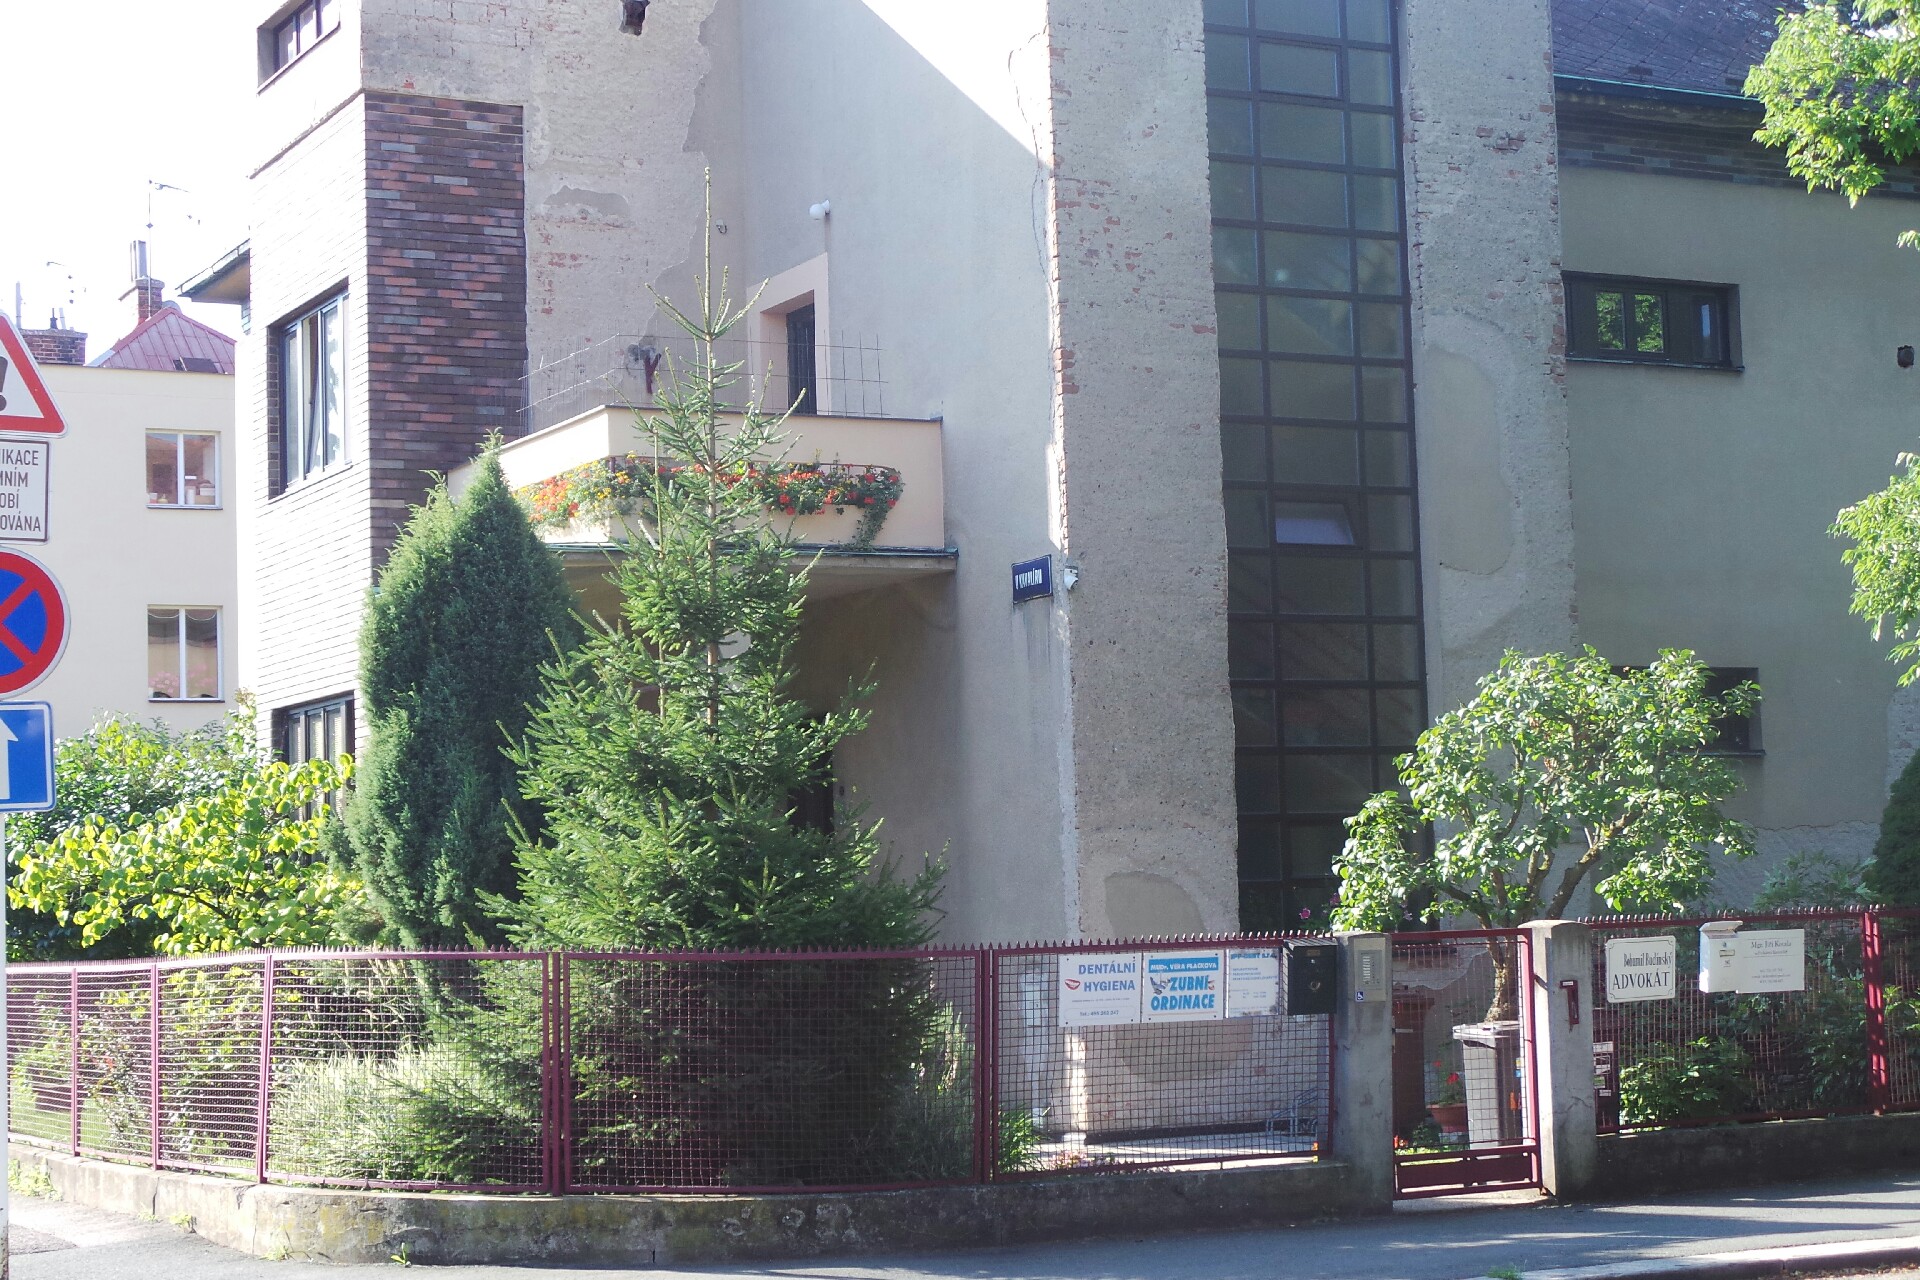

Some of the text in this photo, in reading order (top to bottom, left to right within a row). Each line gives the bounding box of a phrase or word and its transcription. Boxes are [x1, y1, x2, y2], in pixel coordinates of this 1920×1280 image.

[0, 449, 39, 466] IKACE
[0, 489, 20, 509] OBÍ
[0, 511, 41, 533] OVÁNA
[1079, 960, 1136, 975] DENTÁLNÍ
[1084, 980, 1136, 992] HYGIENA
[1169, 975, 1209, 991] ZUBNÍ
[1613, 968, 1670, 990] ADVOKÁT
[1151, 994, 1216, 1011] ORDINACE
